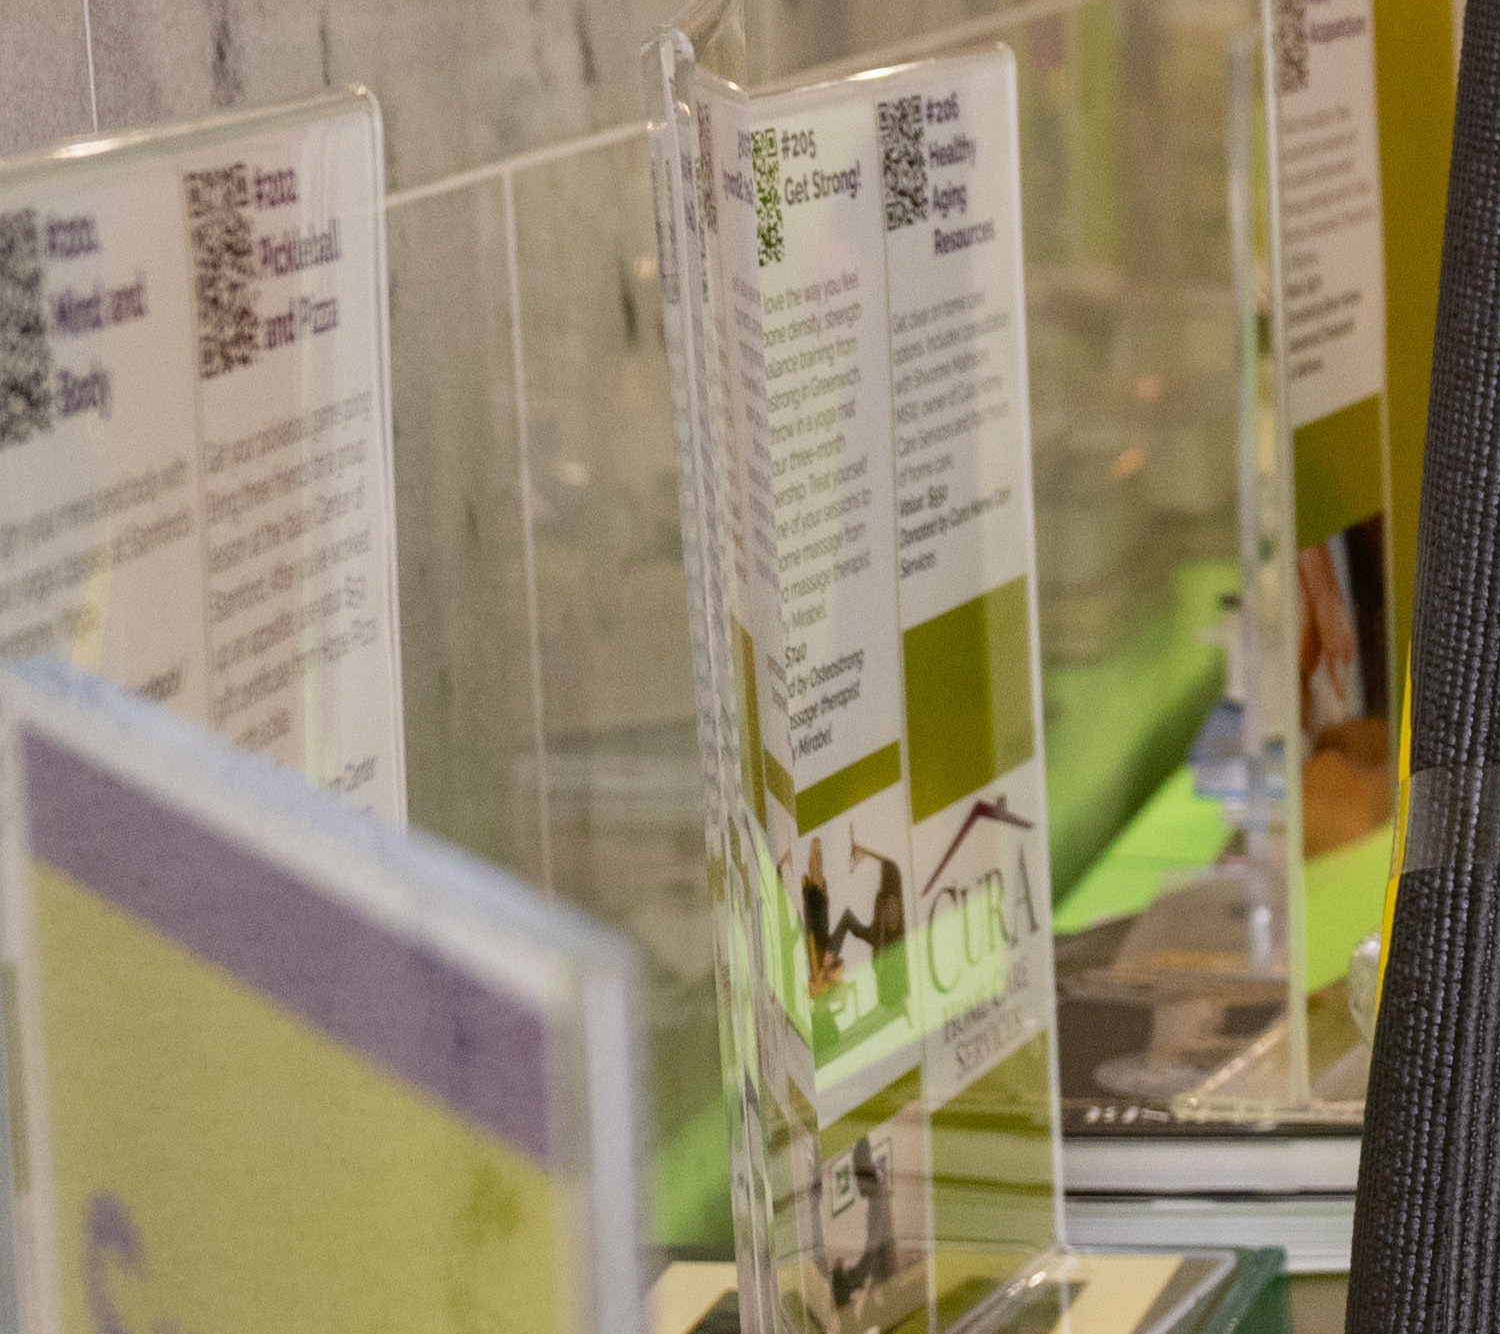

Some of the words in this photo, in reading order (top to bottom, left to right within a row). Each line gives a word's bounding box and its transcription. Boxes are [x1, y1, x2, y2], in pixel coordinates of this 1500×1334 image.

[781, 129, 817, 159] #205
[784, 170, 810, 206] Get
[811, 158, 862, 199] Strong!
[926, 842, 1040, 995] CURA
